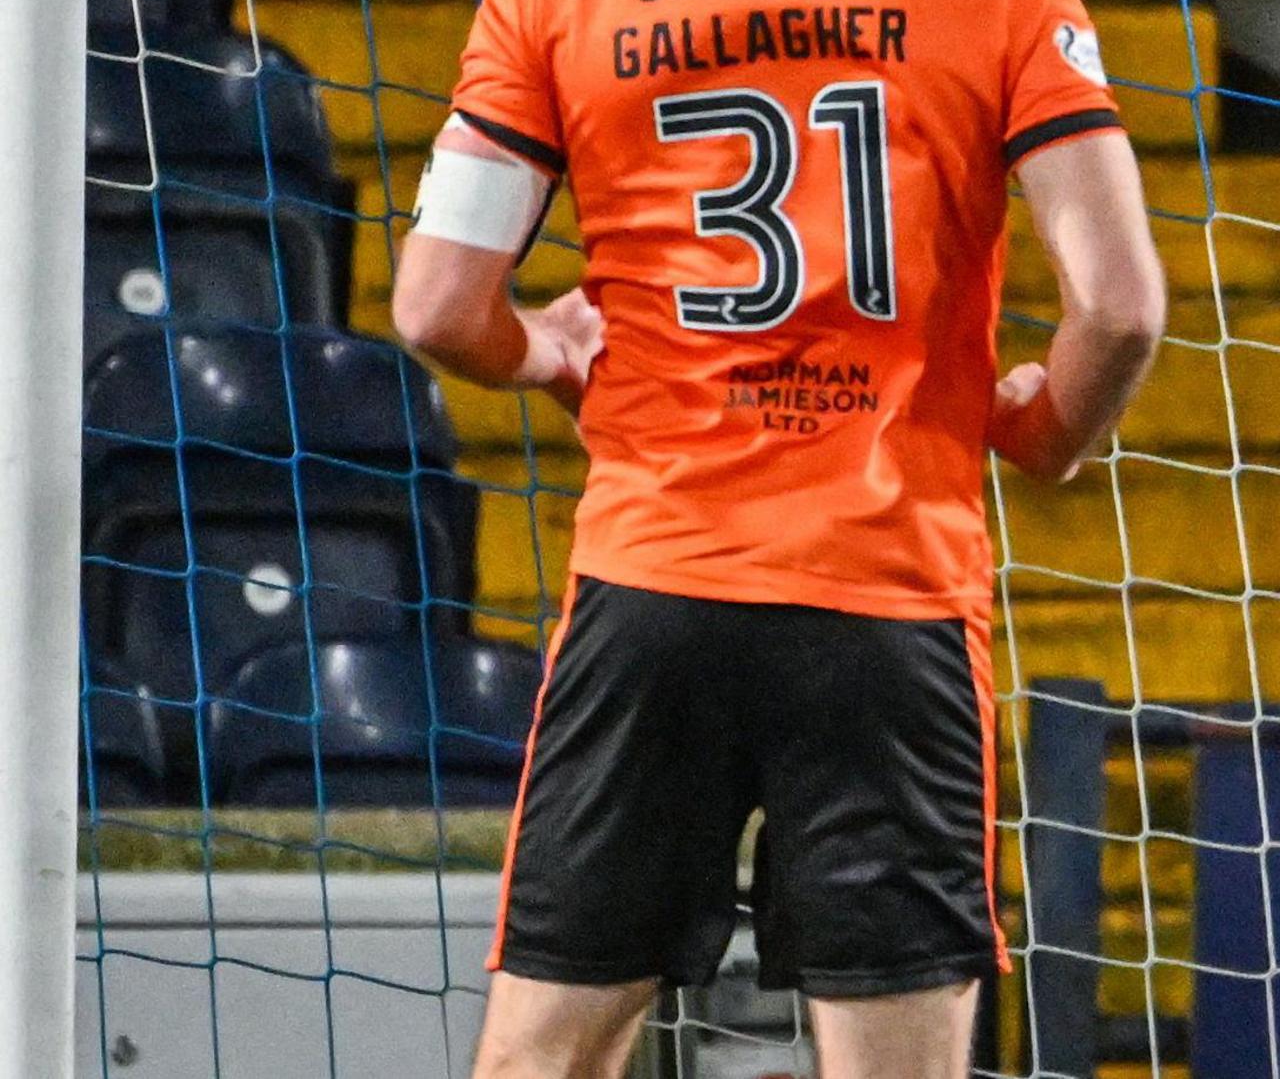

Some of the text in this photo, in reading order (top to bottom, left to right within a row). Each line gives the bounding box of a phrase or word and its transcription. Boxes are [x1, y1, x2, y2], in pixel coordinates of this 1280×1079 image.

[612, 5, 907, 80] GALLAGHER
[653, 80, 896, 333] 31
[728, 359, 871, 387] NORMAN
[724, 385, 878, 413] JAMIESON
[763, 411, 820, 434] LTD
